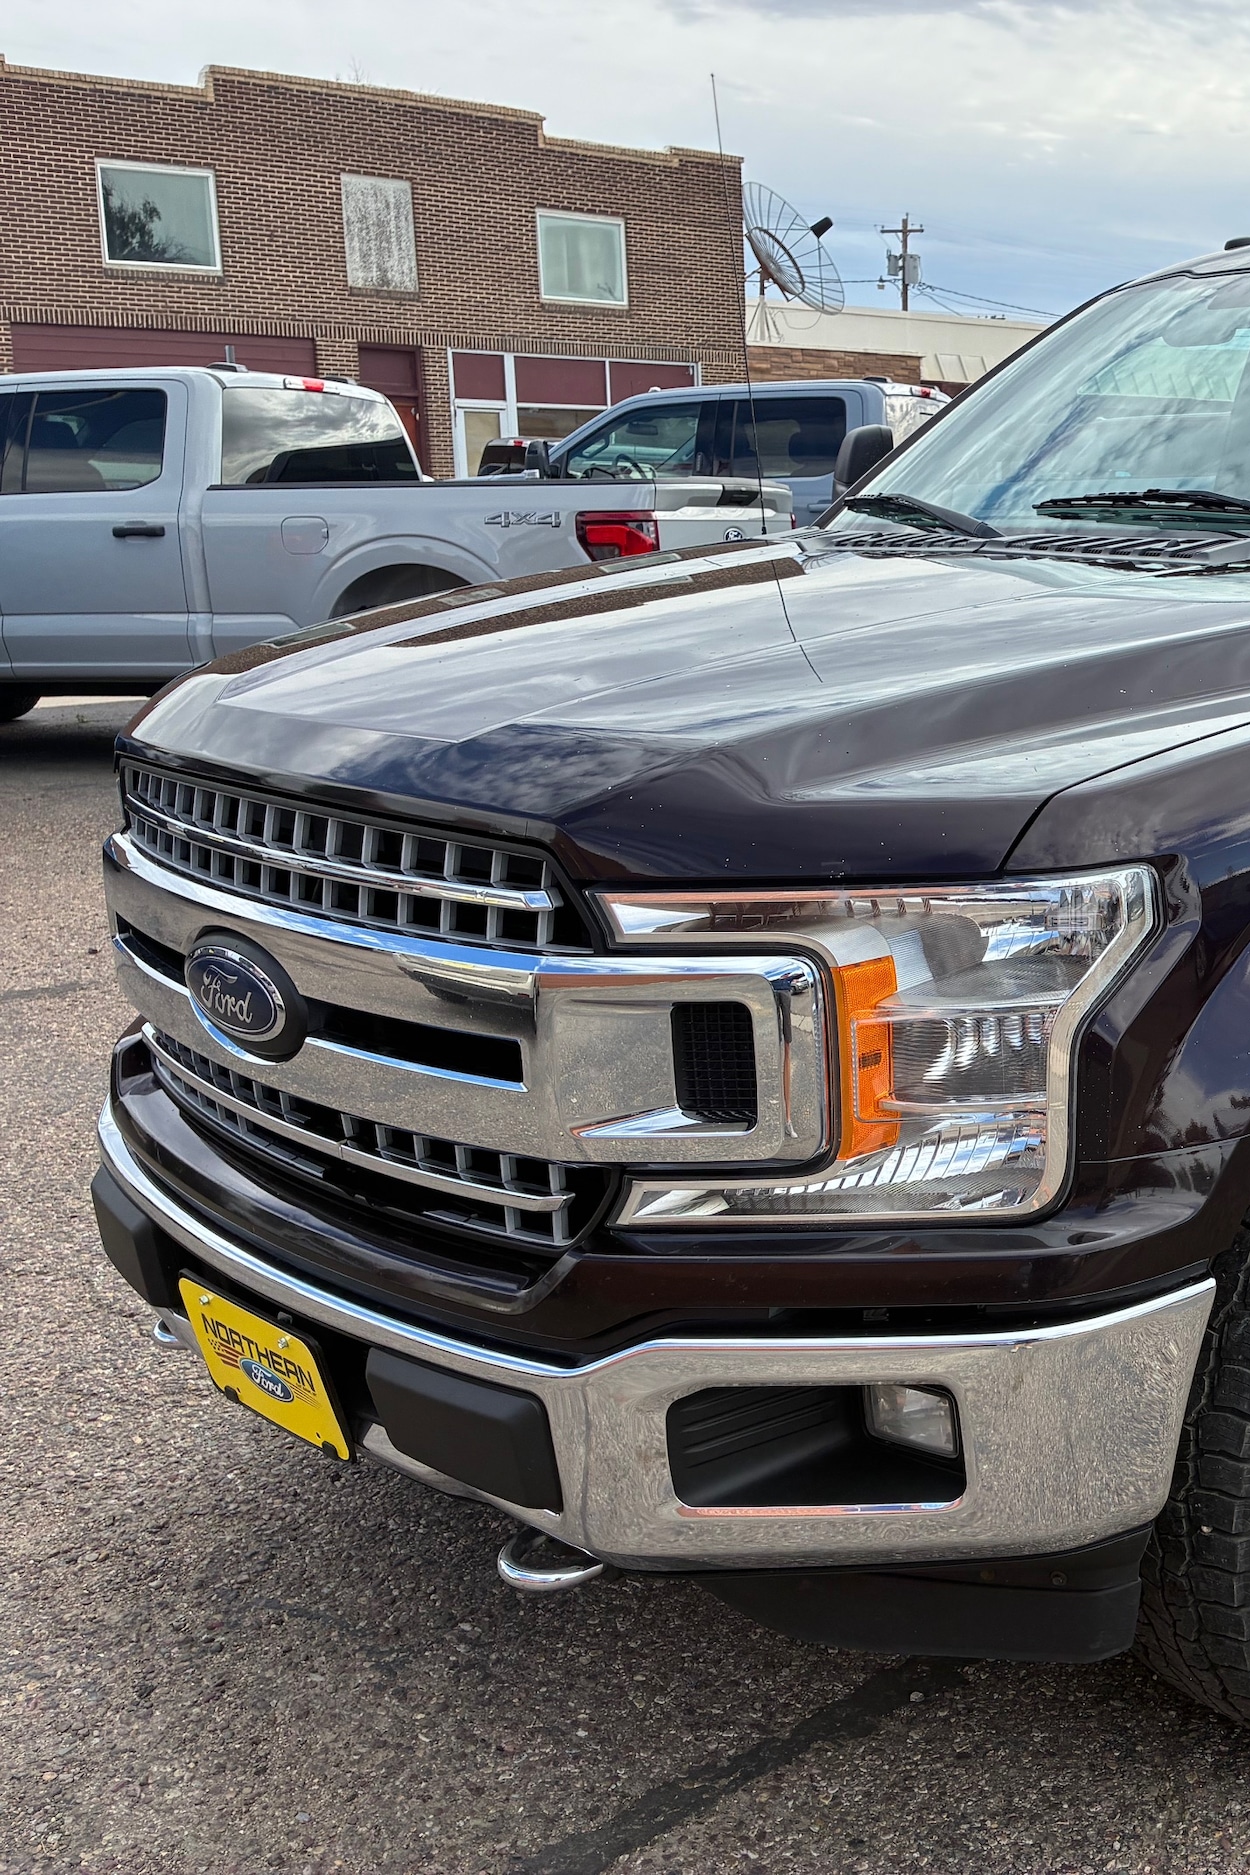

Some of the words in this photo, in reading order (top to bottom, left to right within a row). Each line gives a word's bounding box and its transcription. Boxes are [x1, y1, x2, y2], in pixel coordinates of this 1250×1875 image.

[200, 964, 253, 1023] Ford
[201, 1312, 317, 1393] NORTHERN
[250, 1364, 285, 1399] Ford
